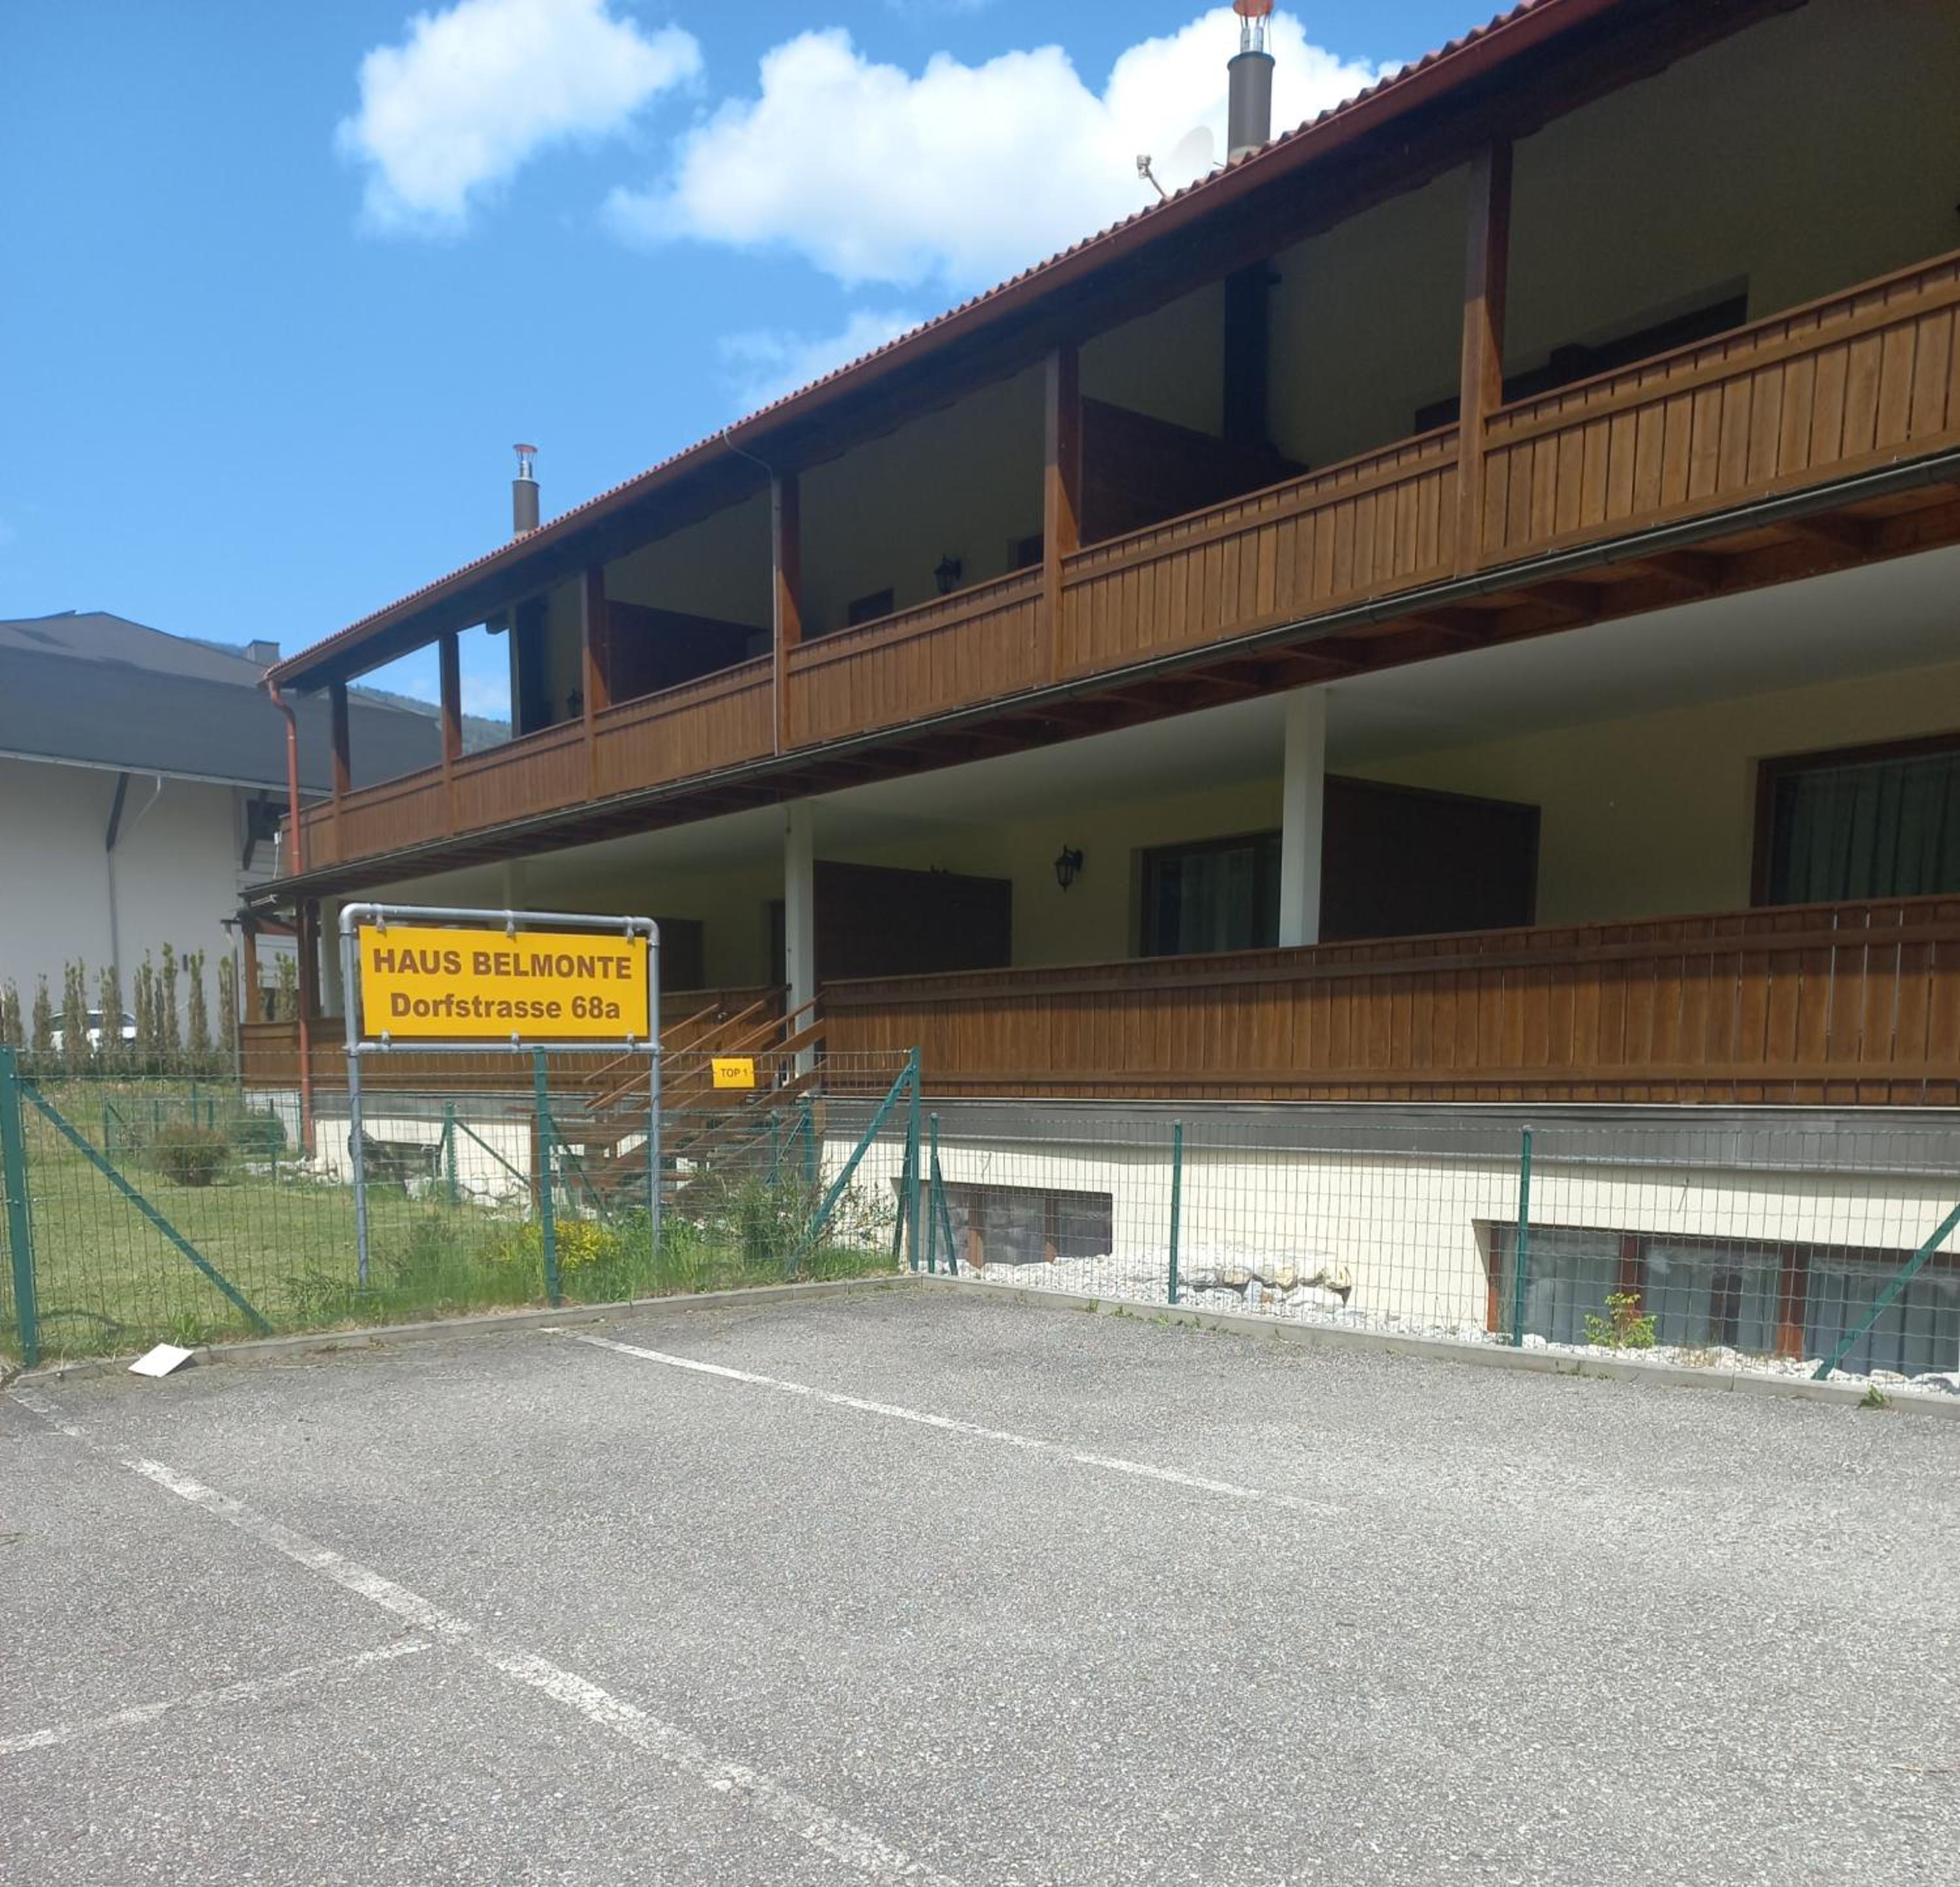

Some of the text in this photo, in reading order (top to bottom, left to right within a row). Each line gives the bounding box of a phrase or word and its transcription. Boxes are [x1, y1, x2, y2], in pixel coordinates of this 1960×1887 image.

[374, 948, 632, 979] HAUS BELMONTE
[391, 993, 620, 1019] Dorfstrasse 68a
[721, 1068, 748, 1077] TOP 1
